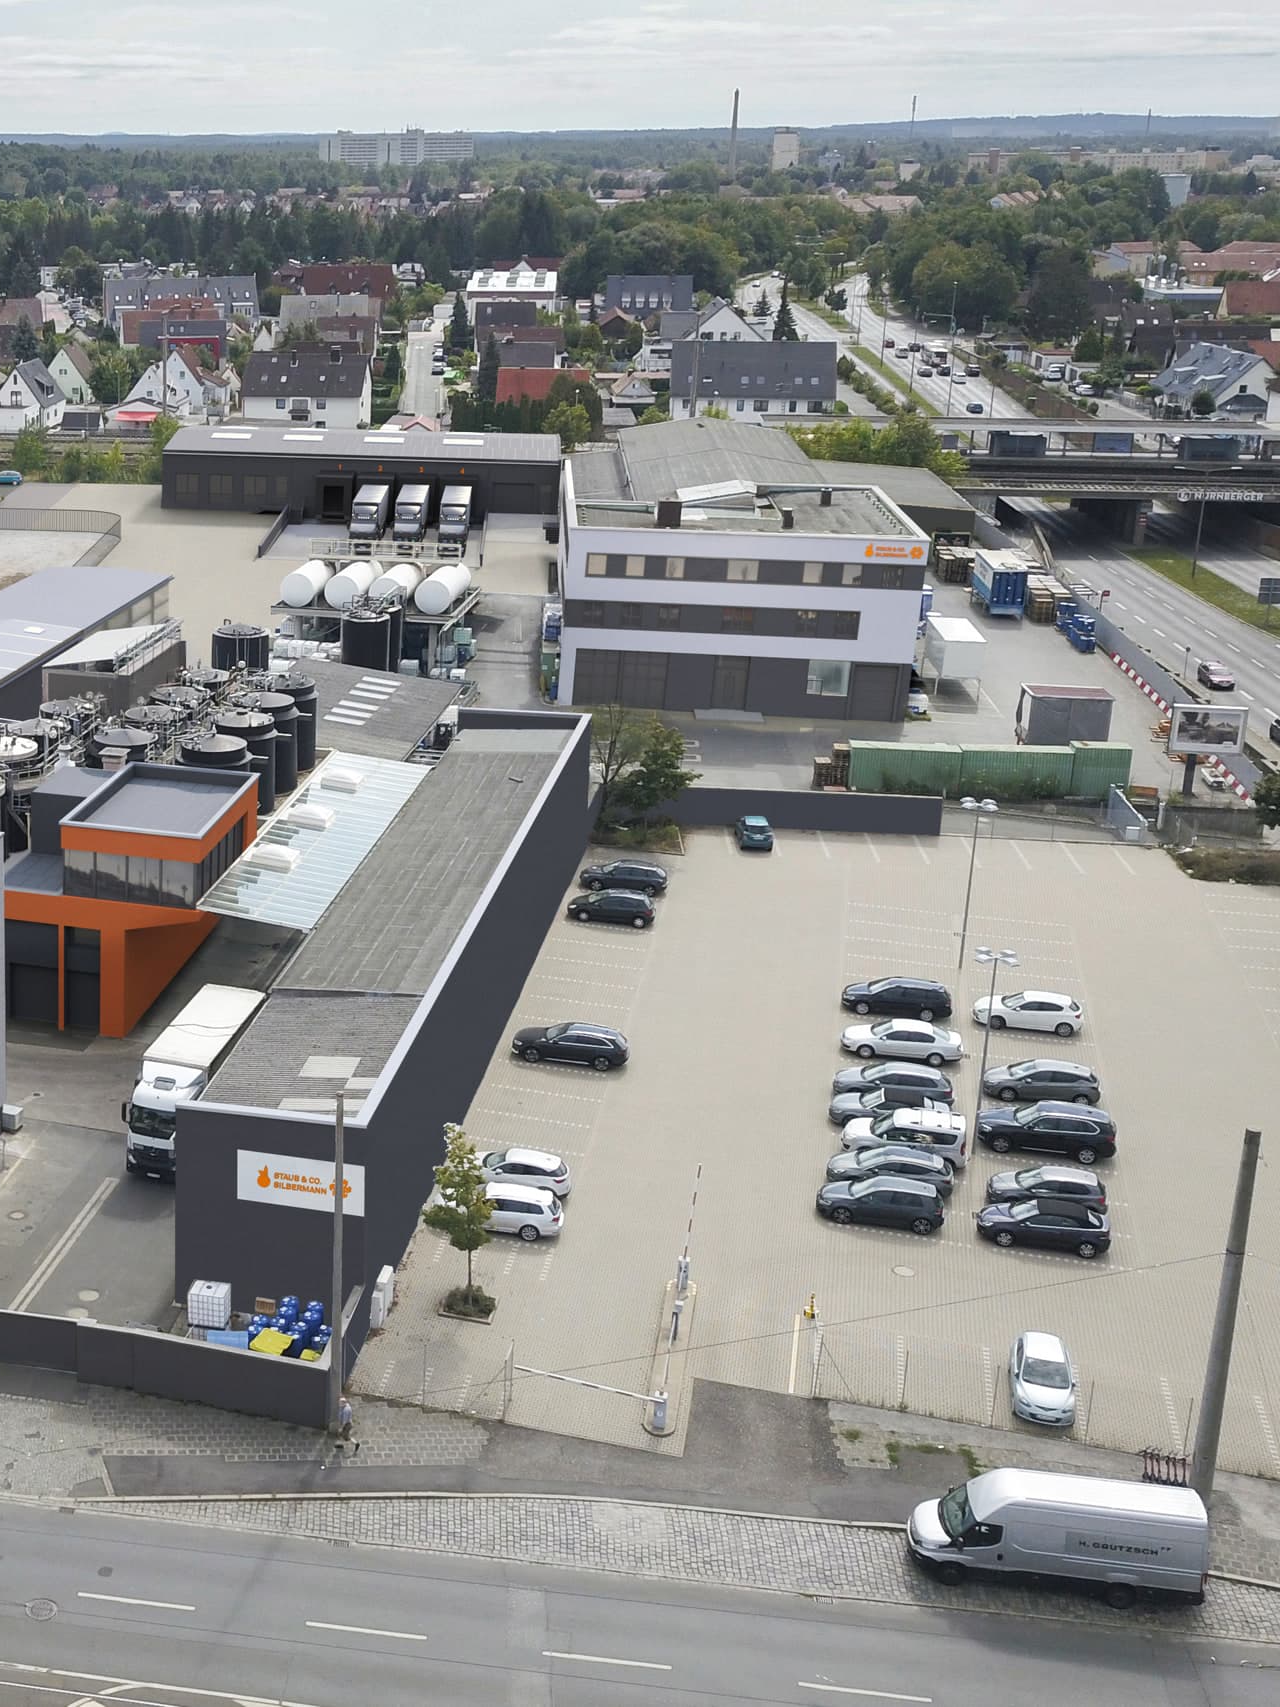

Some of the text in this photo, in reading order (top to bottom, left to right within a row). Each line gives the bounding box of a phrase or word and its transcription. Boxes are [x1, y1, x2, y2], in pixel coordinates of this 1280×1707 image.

[273, 1171, 322, 1185] STAUB & CO.
[273, 1181, 327, 1195] SILBERMANN
